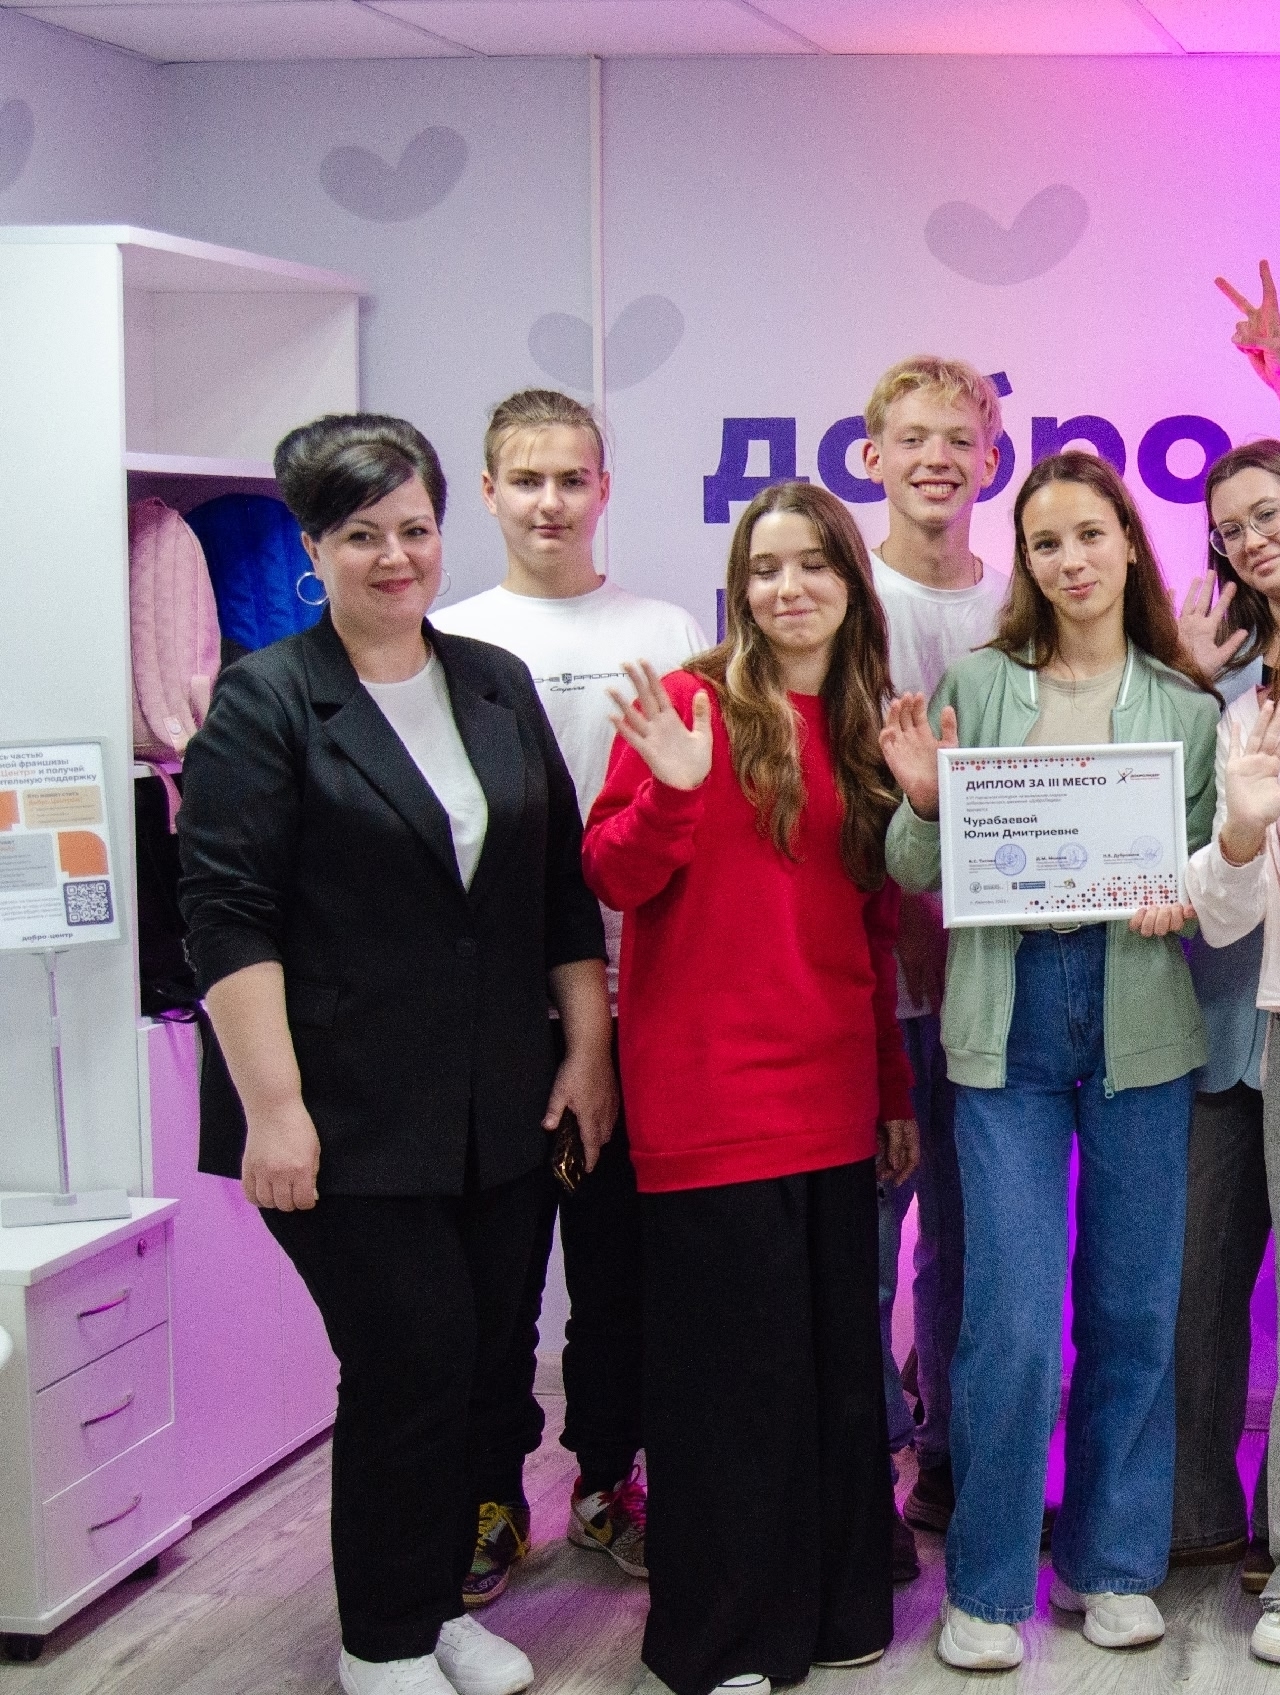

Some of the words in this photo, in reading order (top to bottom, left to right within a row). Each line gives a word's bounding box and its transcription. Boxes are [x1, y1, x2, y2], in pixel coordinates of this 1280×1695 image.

[46, 765, 85, 775] получай
[45, 774, 97, 783] поддержку
[966, 779, 1025, 792] ДИПЛОМ
[1029, 778, 1045, 788] ЗА
[1048, 778, 1059, 787] III
[1062, 776, 1107, 787] МЕСТО
[963, 814, 1038, 828] Чурабаевой
[964, 830, 999, 840] Юлии
[1002, 827, 1079, 840] Дмитриевне
